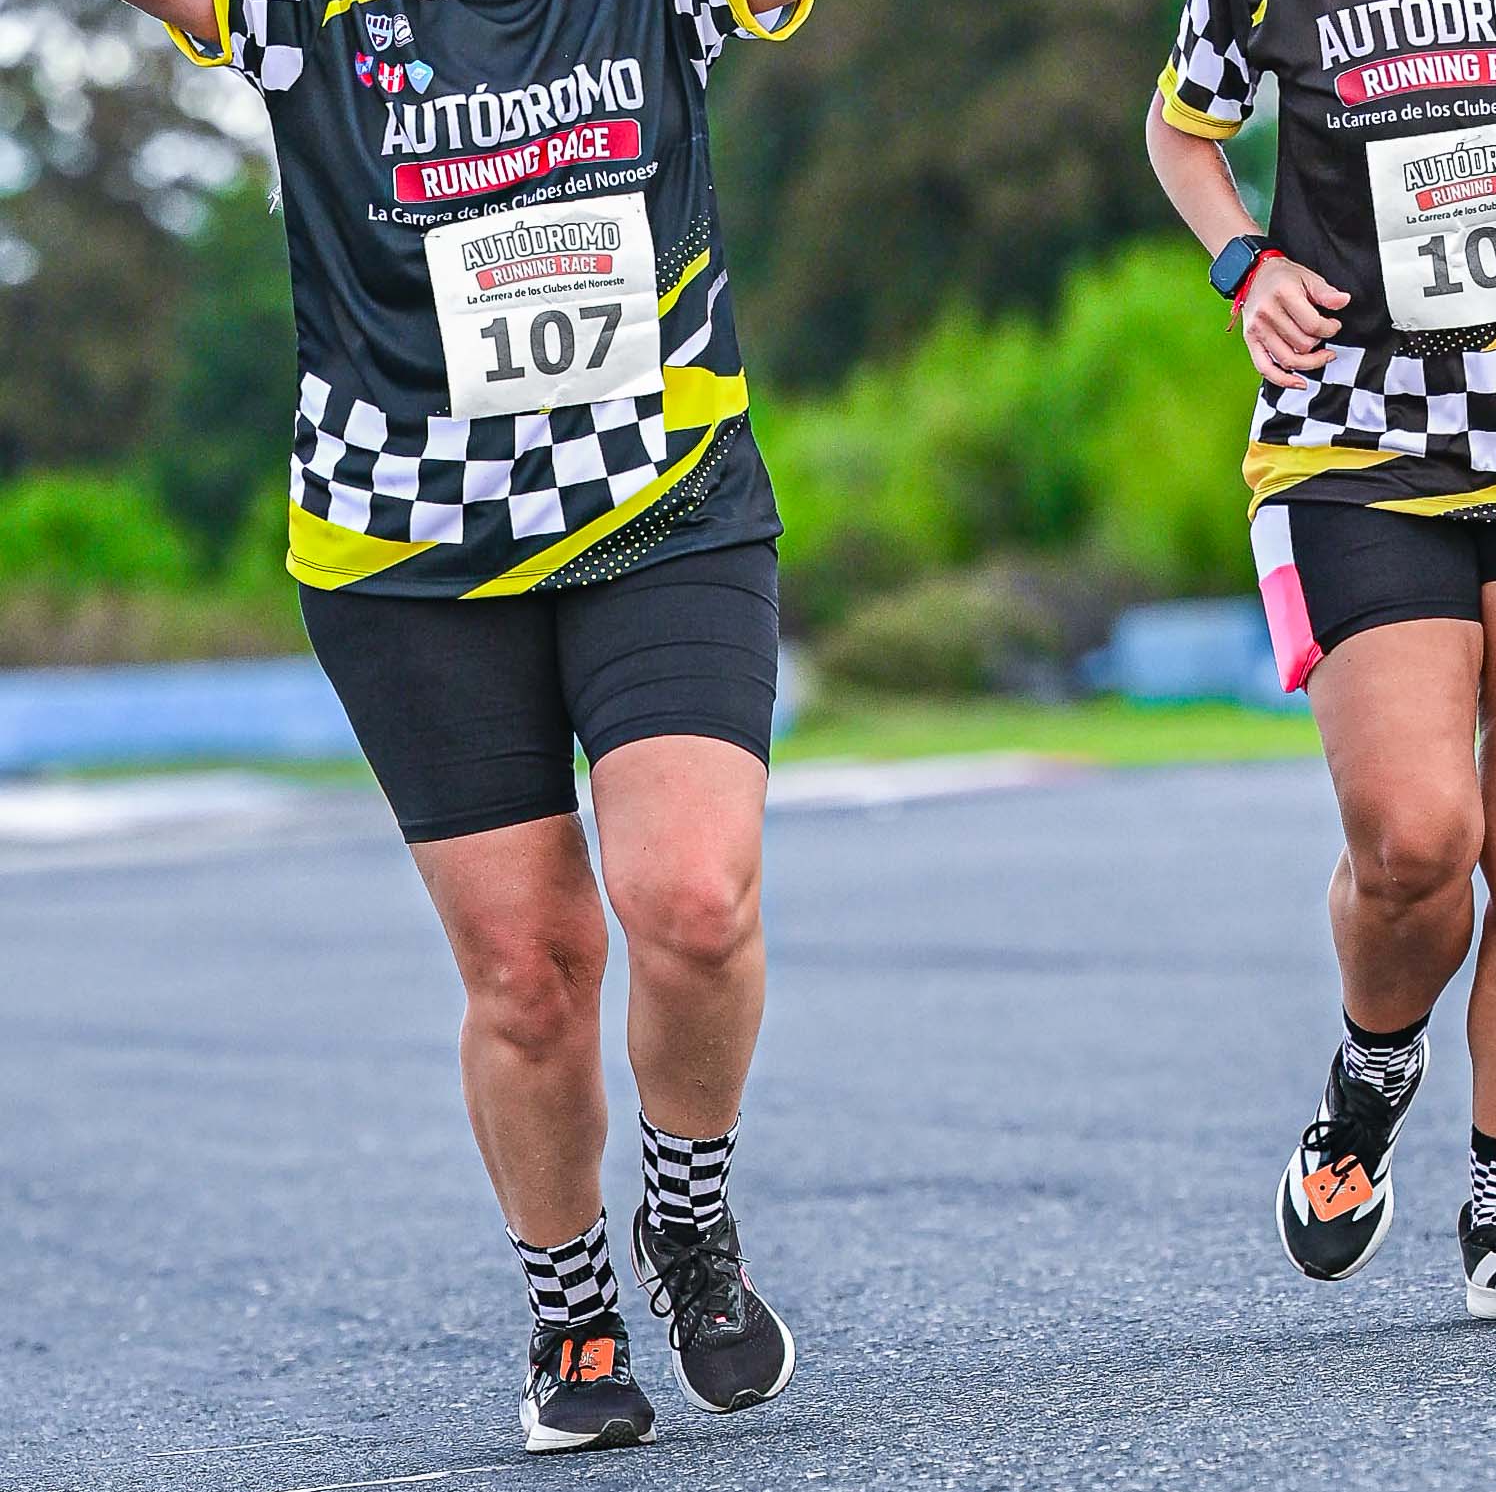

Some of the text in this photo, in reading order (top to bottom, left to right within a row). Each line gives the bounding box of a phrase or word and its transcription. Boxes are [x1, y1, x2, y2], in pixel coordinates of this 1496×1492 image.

[1361, 53, 1480, 98] RUNNING
[381, 58, 645, 156] AUTÓDROMO
[1327, 113, 1341, 129] La
[1342, 110, 1397, 128] Carrera
[1401, 104, 1423, 121] de
[1425, 101, 1451, 119] los
[421, 127, 610, 198] RUNNING RACE
[368, 161, 659, 227] La Carrera de los Clubes del Noroest
[1407, 216, 1417, 224] La
[1418, 211, 1451, 222] Carrera
[1453, 207, 1463, 218] de
[1465, 205, 1477, 215] los
[1431, 179, 1493, 206] RUNNING
[461, 221, 621, 271] AUTÓDROMO
[467, 277, 625, 305] La Carrera de los Clubes del Noroeste
[491, 256, 598, 285] RUNNING RACE
[480, 303, 622, 383] 107
